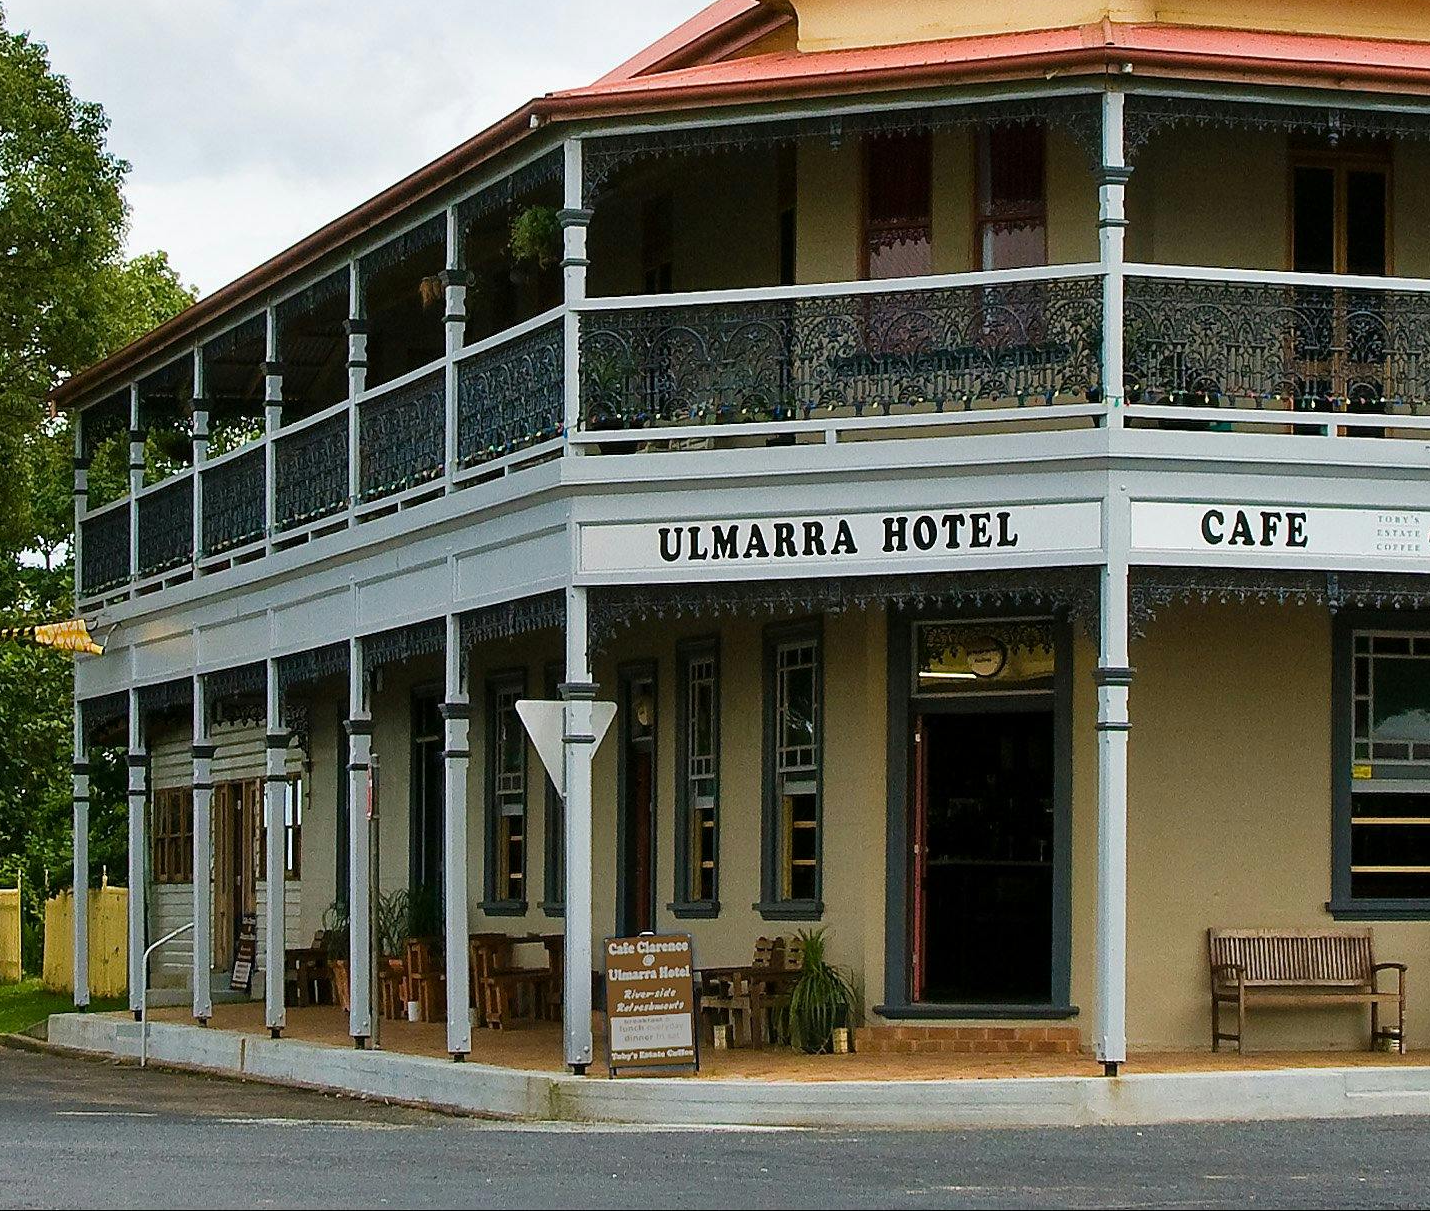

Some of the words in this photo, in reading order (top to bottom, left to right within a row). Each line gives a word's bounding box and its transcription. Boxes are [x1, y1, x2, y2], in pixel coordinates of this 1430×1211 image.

[1377, 515, 1420, 523] TOBY'S
[1201, 509, 1309, 548] CAFE
[1377, 529, 1420, 537] ESTATE
[658, 518, 858, 562] ULMARRA
[882, 511, 1019, 553] HOTEL
[1376, 543, 1420, 551] COFFEE
[608, 942, 635, 955] Cafe
[636, 941, 689, 953] Clarence
[608, 969, 657, 981] Ulmarra
[659, 965, 690, 979] Hotel
[616, 1001, 684, 1012] Refreshments
[624, 1034, 653, 1042] dinner
